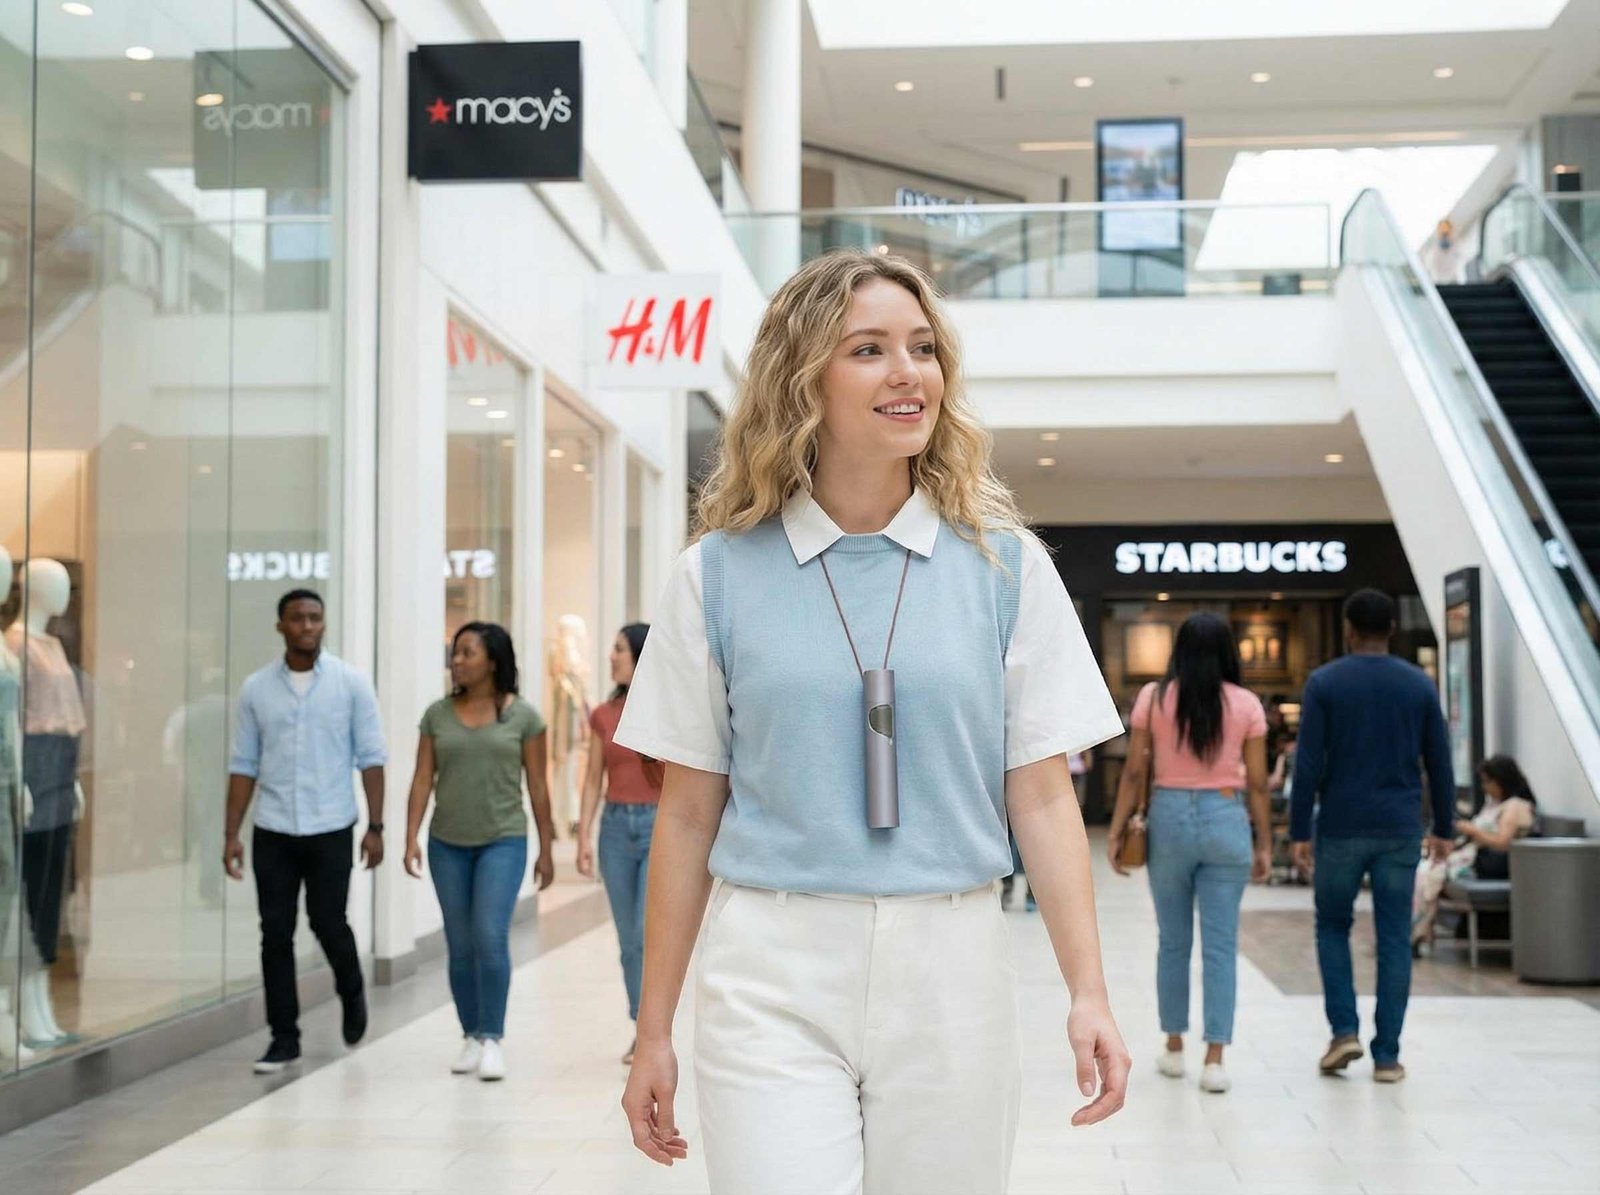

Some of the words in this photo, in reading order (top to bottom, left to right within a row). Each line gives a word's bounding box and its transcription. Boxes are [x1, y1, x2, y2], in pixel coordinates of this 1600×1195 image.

[455, 87, 572, 131] macy's
[607, 296, 713, 364] H&M
[1115, 540, 1347, 574] STARBUCKS
